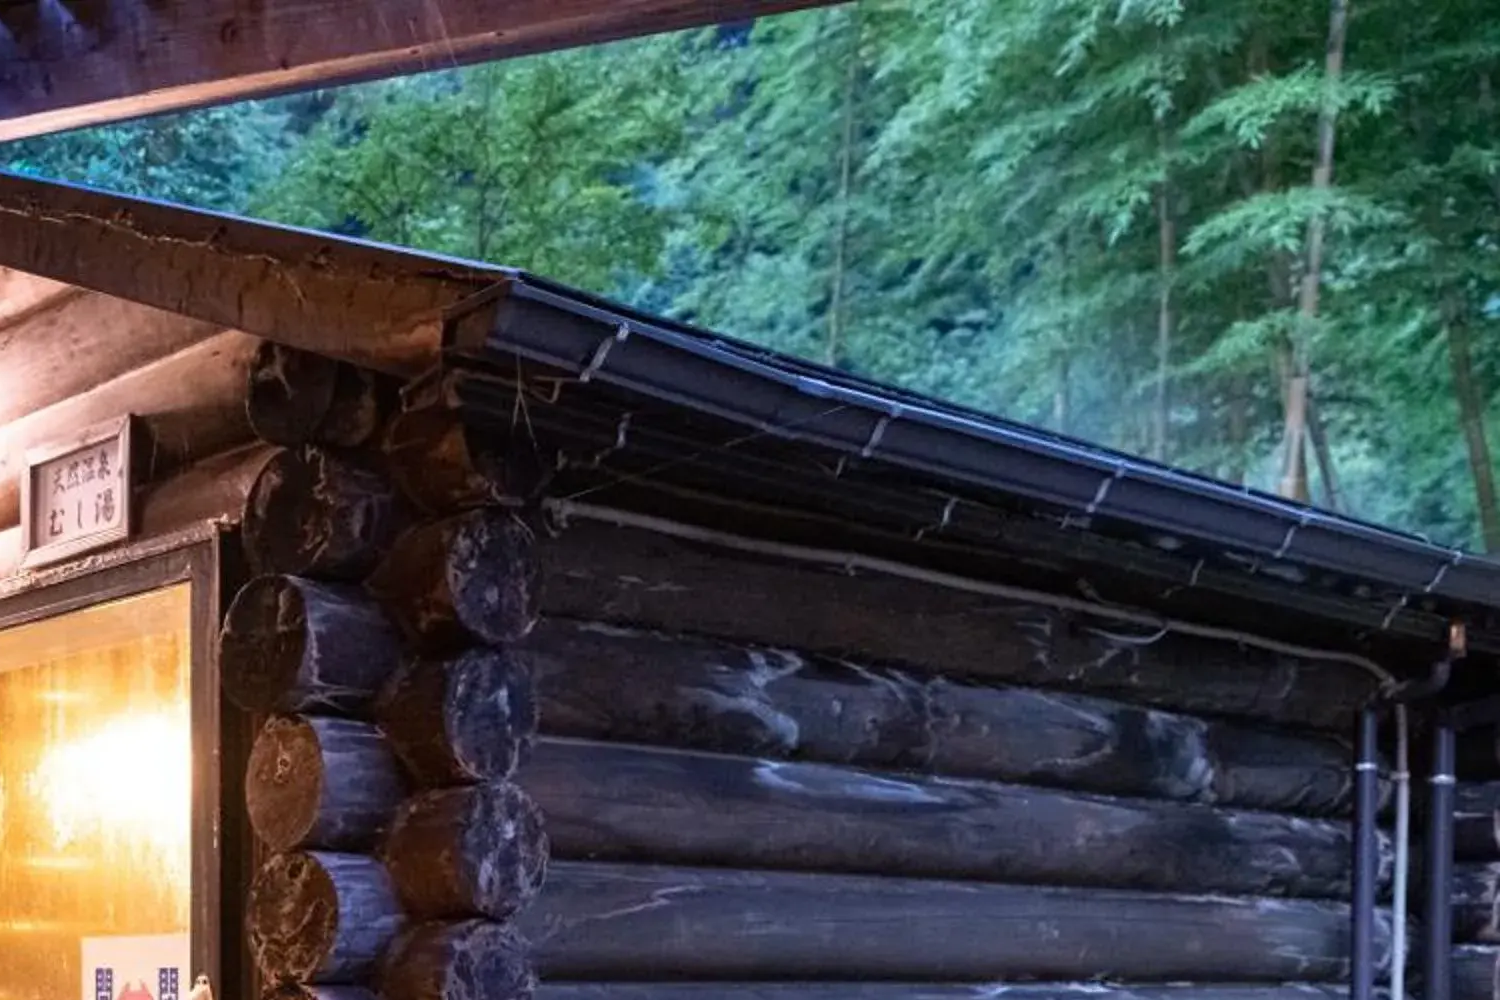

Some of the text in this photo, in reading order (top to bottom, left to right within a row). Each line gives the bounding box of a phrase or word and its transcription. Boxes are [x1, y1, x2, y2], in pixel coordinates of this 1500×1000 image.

[52, 449, 111, 494] 天然温泉
[49, 487, 115, 537] むし湯
